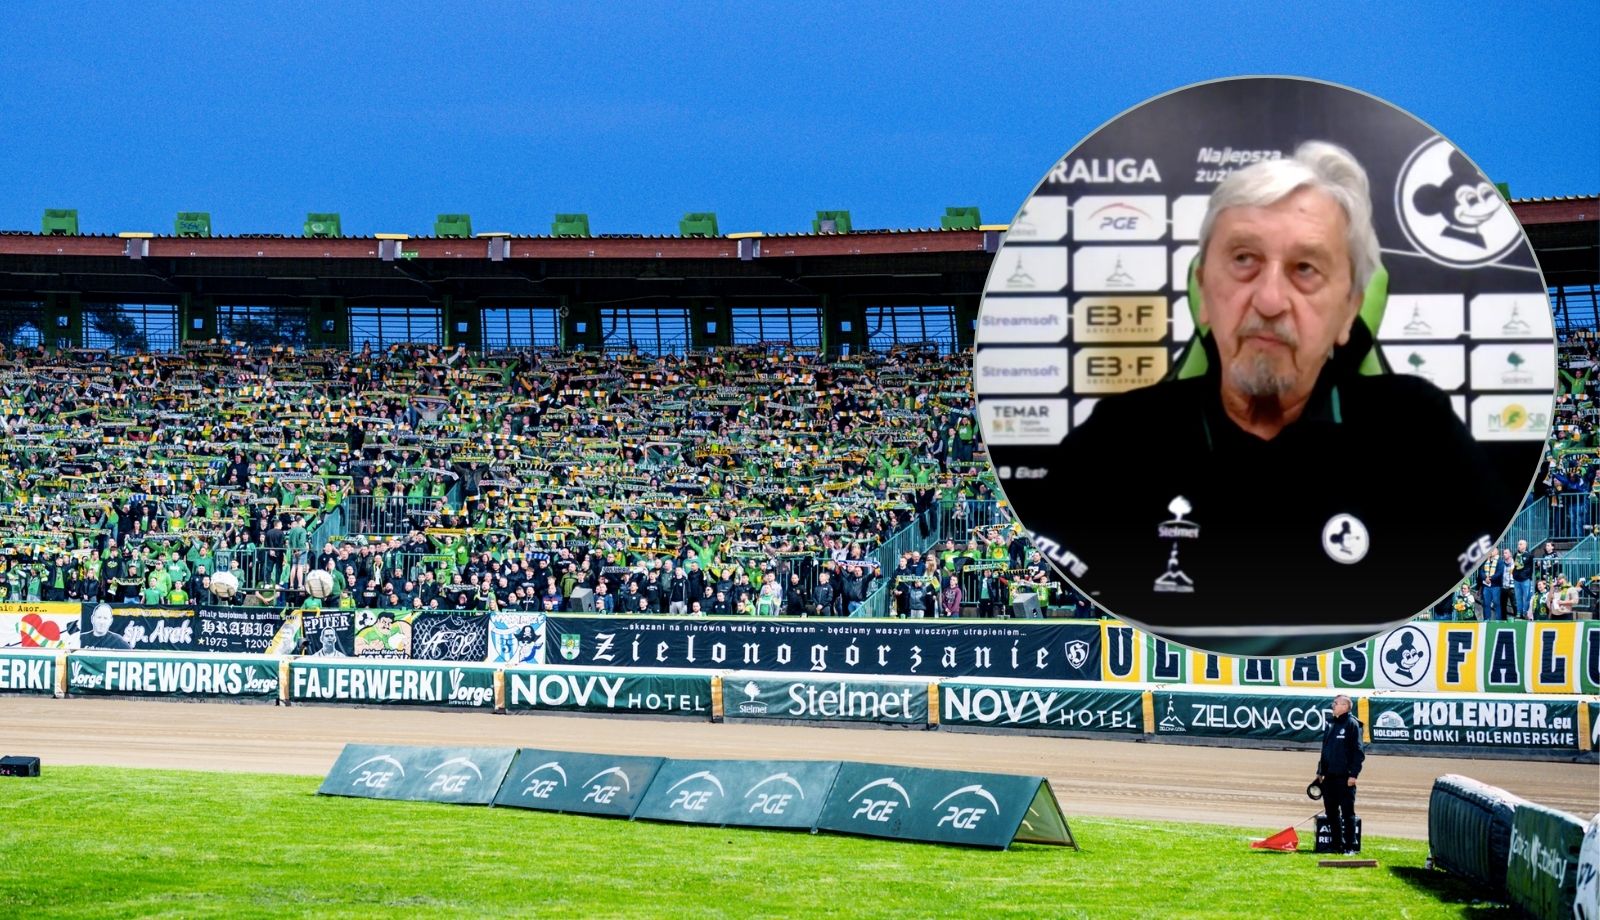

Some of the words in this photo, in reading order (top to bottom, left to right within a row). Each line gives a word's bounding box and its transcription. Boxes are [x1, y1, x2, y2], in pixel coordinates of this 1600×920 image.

[1197, 147, 1283, 166] Najlepsza
[1100, 216, 1139, 231] PGE
[982, 314, 1059, 327] Streamsoft
[982, 365, 1060, 377] Streamsoft
[993, 405, 1049, 418] TEMAR
[1158, 525, 1200, 538] Stelmet
[149, 619, 193, 644] Arek
[201, 619, 274, 637] HRABIA
[311, 615, 350, 630] PITER
[684, 624, 726, 633] nierówną
[730, 625, 757, 634] walkę
[770, 626, 816, 635] systemem
[827, 626, 871, 636] będziemy
[876, 628, 911, 636] waszym
[914, 628, 959, 637] wiecznym
[592, 632, 1049, 673] Zielonogórzanie
[105, 661, 242, 694] FIREWORKS
[293, 667, 443, 701] FAJERWERKI
[511, 674, 625, 708] NOVY
[628, 693, 705, 712] HOTEL
[788, 682, 913, 718] Stelmet
[739, 704, 768, 714] Stelmet
[945, 687, 1058, 724] NOVY
[1060, 709, 1136, 728] HOTEL
[1191, 703, 1286, 729] ZIELONA
[1413, 701, 1572, 730] HOLENDER.eu
[1373, 728, 1410, 738] HOLENDER
[1413, 729, 1460, 743] DOMKI
[1466, 731, 1574, 746] HOLENDERSKIE
[352, 770, 394, 789] PGE
[428, 774, 471, 793] PGE
[522, 779, 558, 799] PGE
[583, 785, 621, 804] PGE
[669, 790, 713, 811] PGE
[749, 793, 793, 815] PGE
[852, 798, 899, 822] PGE
[936, 806, 987, 829] PGE
